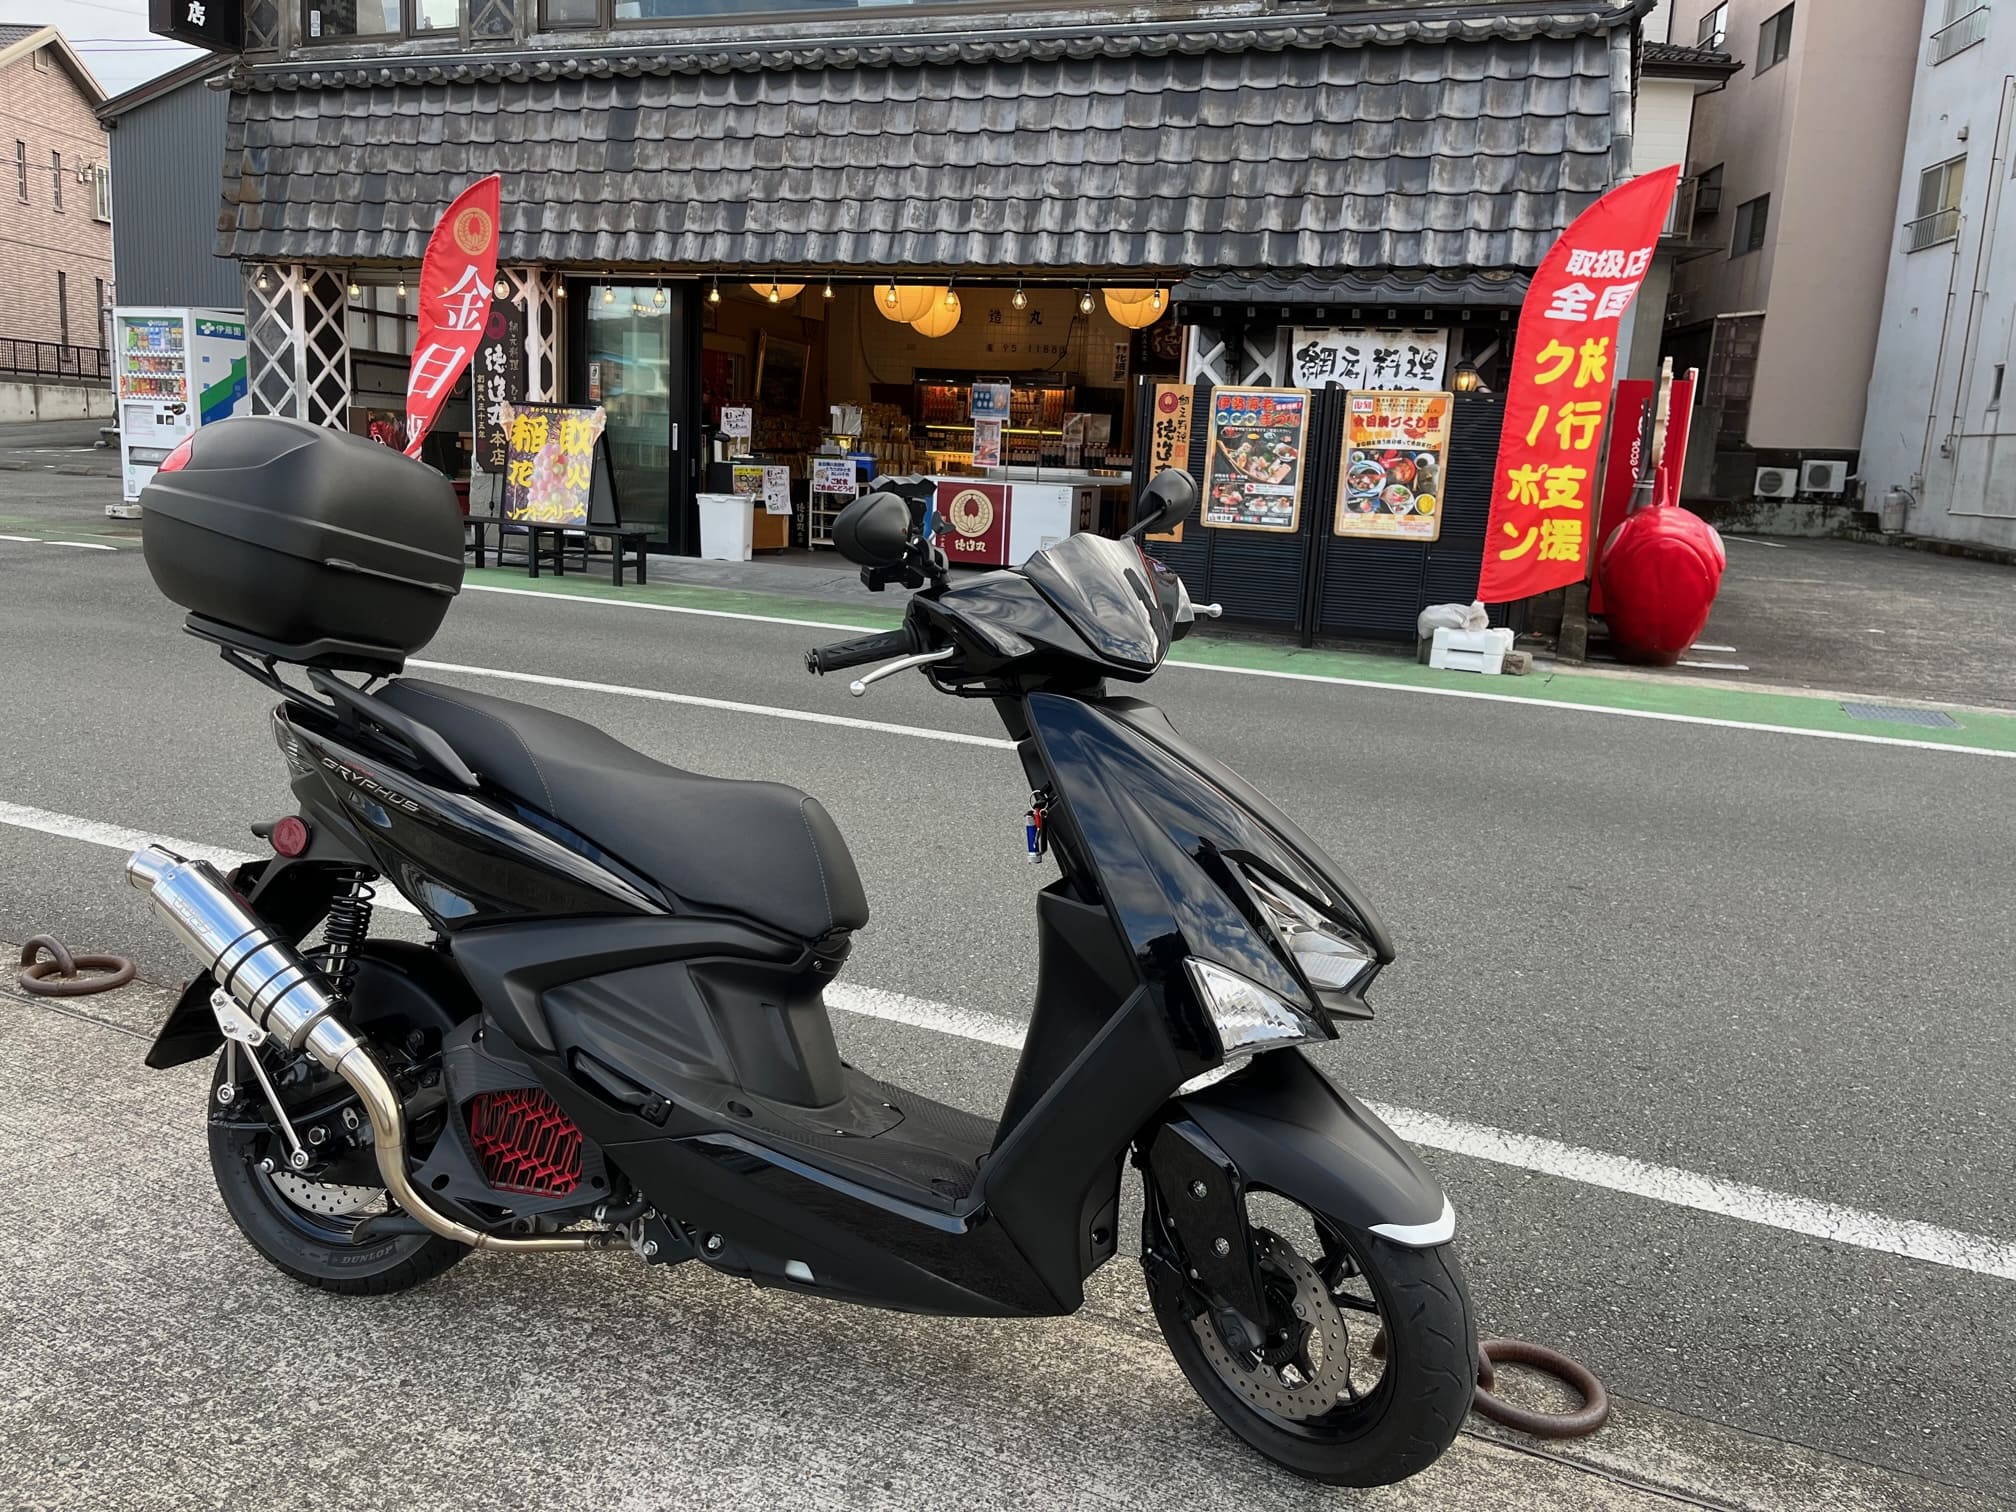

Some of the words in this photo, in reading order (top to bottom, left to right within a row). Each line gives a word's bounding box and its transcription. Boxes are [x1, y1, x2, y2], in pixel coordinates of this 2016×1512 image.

[187, 0, 206, 27] 店
[1565, 246, 1652, 280] 取扱店
[1544, 281, 1640, 321] 全国
[1297, 341, 1439, 382] 網元料理
[489, 430, 506, 466] 本店
[321, 757, 420, 813] GRYPHUS
[341, 1245, 393, 1264] DUNLOP
